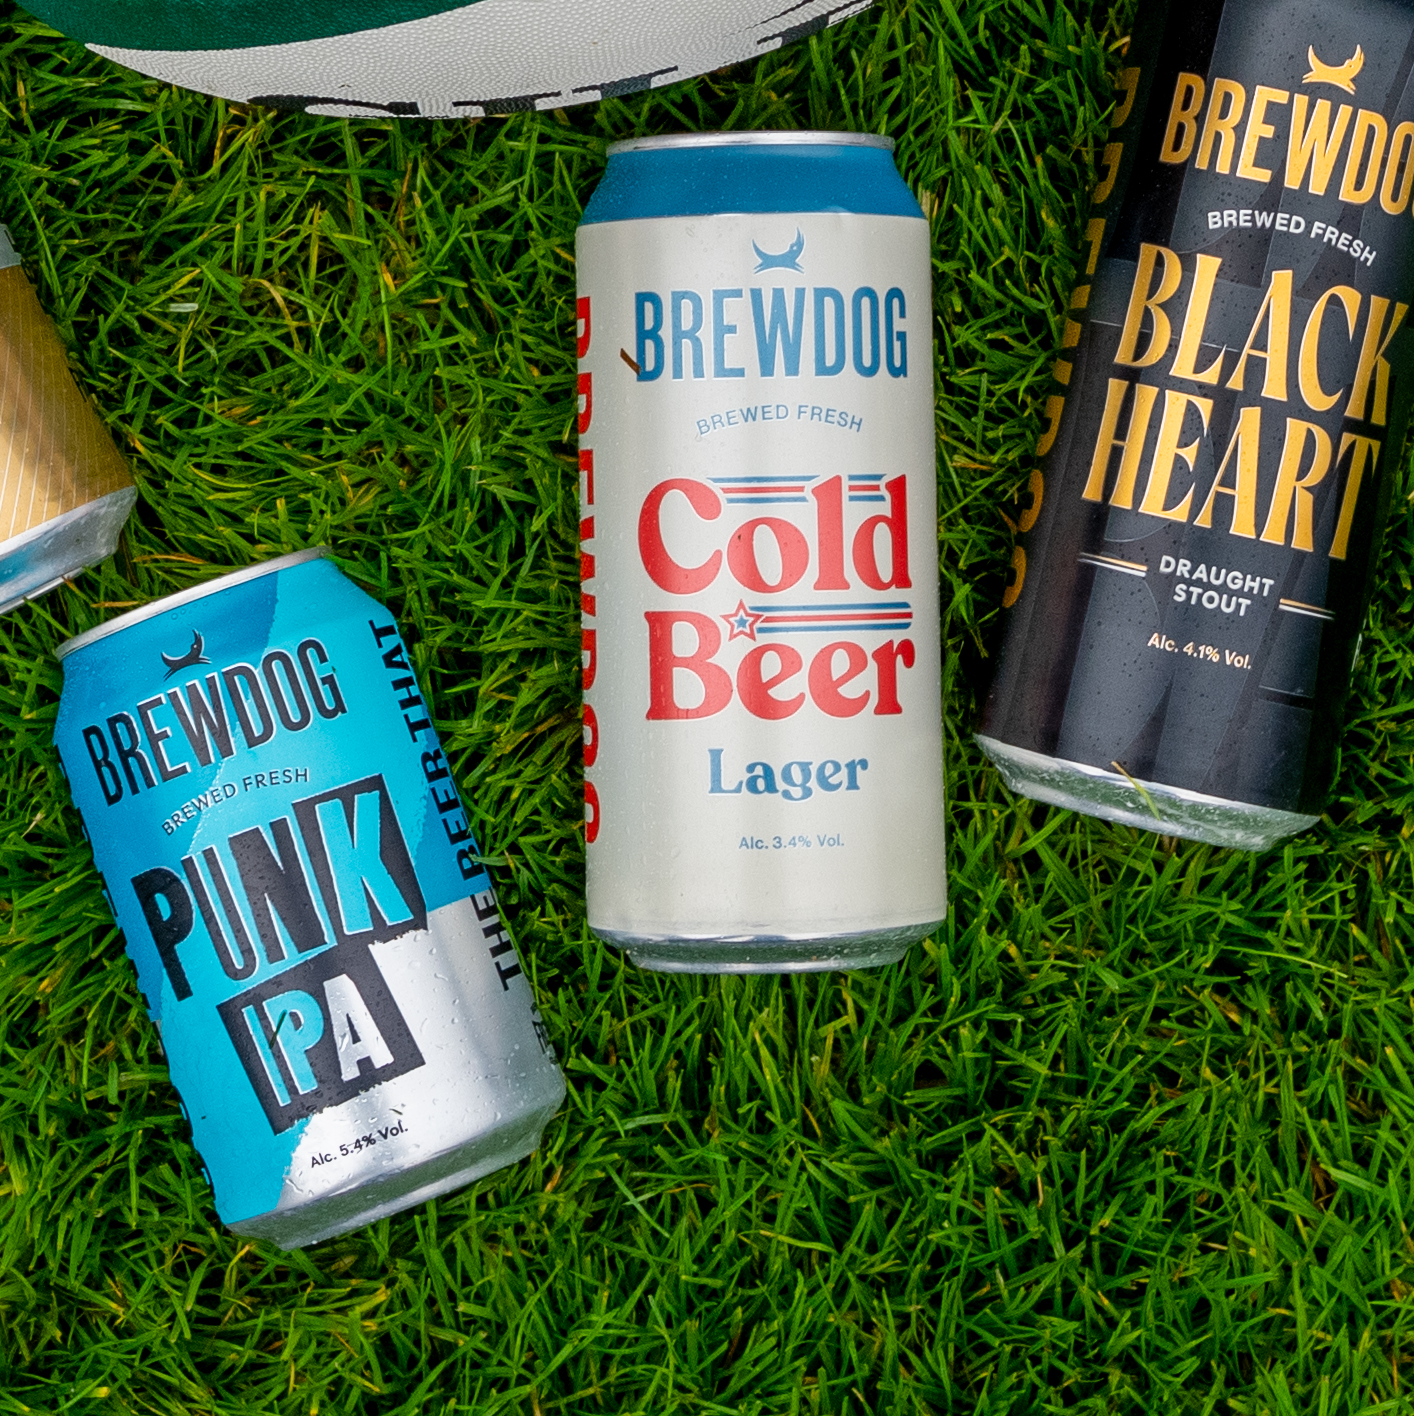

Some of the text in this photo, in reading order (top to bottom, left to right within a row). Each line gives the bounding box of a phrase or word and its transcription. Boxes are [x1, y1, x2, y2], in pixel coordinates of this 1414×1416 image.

[1207, 208, 1377, 269] BREWED FRESH
[635, 284, 908, 383] BREWDOG
[1113, 241, 1412, 426] BLACK
[695, 404, 864, 437] BREWED FRESH
[1081, 378, 1381, 561] HEART
[638, 474, 914, 596] Cold
[1159, 554, 1276, 598] DRAUGHT
[1173, 583, 1253, 618] STOUT
[644, 609, 917, 722] Beer
[1147, 632, 1253, 671] Alc. 4.1% Vol.
[82, 636, 347, 807] BREWDOG
[161, 766, 310, 837] BREWED FRESH
[368, 619, 522, 992] THE BEER THAT
[708, 749, 868, 803] Lager
[738, 834, 846, 851] Alc. 3.4% Vol.
[131, 789, 415, 1003] PUNK
[241, 973, 395, 1107] IPA
[310, 1121, 410, 1170] Alc. 5.4% Vol.
